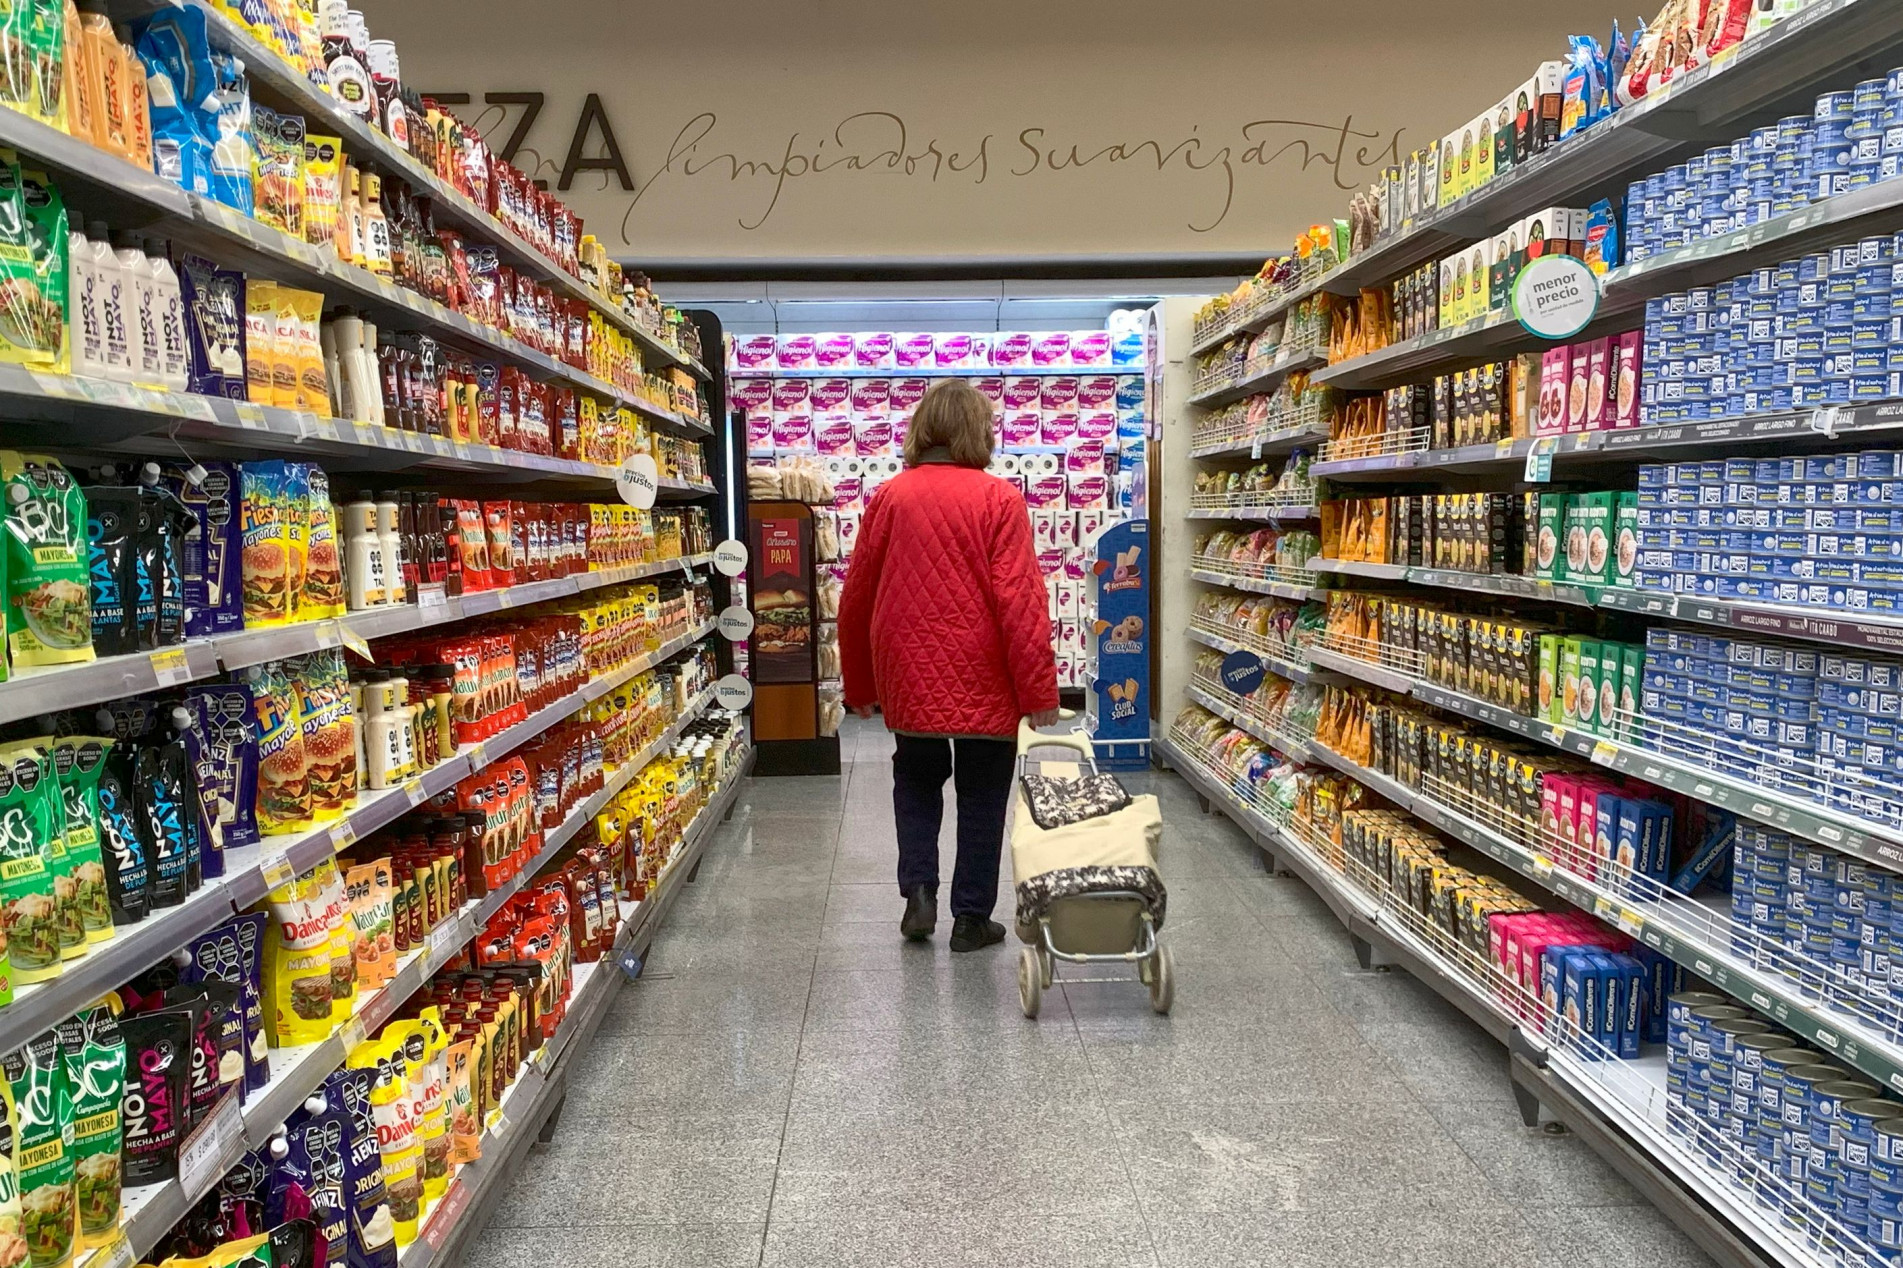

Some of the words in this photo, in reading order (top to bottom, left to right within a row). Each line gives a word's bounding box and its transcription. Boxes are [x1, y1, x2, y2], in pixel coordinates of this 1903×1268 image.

[620, 112, 993, 246] limpiadores
[1533, 272, 1577, 293] menor
[1536, 286, 1579, 309] precio
[86, 277, 100, 337] MAYO
[104, 299, 116, 341] NOT
[111, 284, 124, 342] MAYO
[81, 293, 92, 335] NOT
[143, 291, 157, 347] MAYO
[139, 306, 150, 346] NOT
[163, 312, 174, 351] NOT
[169, 297, 181, 352] MAYO
[740, 344, 773, 356] Higienol
[780, 344, 813, 356] Higienol
[858, 342, 891, 355] Higienol
[737, 388, 770, 400] Higienol
[776, 387, 805, 399] Higienol
[814, 387, 847, 399] Higienol
[856, 388, 889, 400] Higienol
[891, 386, 923, 398] Higienol
[1006, 386, 1038, 398] Higienol
[1043, 386, 1076, 398] Higienol
[1081, 386, 1114, 397] Higienol
[776, 424, 808, 435] Higienol
[1005, 422, 1037, 433] Higienol
[1043, 422, 1076, 434] Higienol
[1080, 421, 1113, 433] Higienol
[818, 431, 851, 443] Higienol
[856, 431, 890, 443] Higienol
[1069, 448, 1101, 460] Higienol
[625, 468, 647, 479] precios
[629, 475, 655, 492] justos
[1029, 484, 1062, 496] Higienol
[1071, 484, 1105, 496] Higienol
[722, 555, 743, 563] justos
[770, 549, 792, 564] PAPA
[726, 620, 748, 628] justos
[1741, 615, 1755, 624] ARROZ
[1755, 616, 1769, 626] LARGO
[1770, 618, 1781, 628] FINO
[1234, 664, 1259, 682] justos
[725, 689, 746, 697] justos
[1114, 701, 1132, 711] CLUB
[1877, 845, 1898, 861] ARROZ
[283, 912, 328, 942] Dánica
[122, 1080, 149, 1139] NOT
[139, 1049, 170, 1133] MAYO
[75, 1114, 115, 1136] MAYONESA
[126, 1138, 154, 1150] HECHA
[154, 1136, 161, 1144] A
[161, 1130, 176, 1142] BASE
